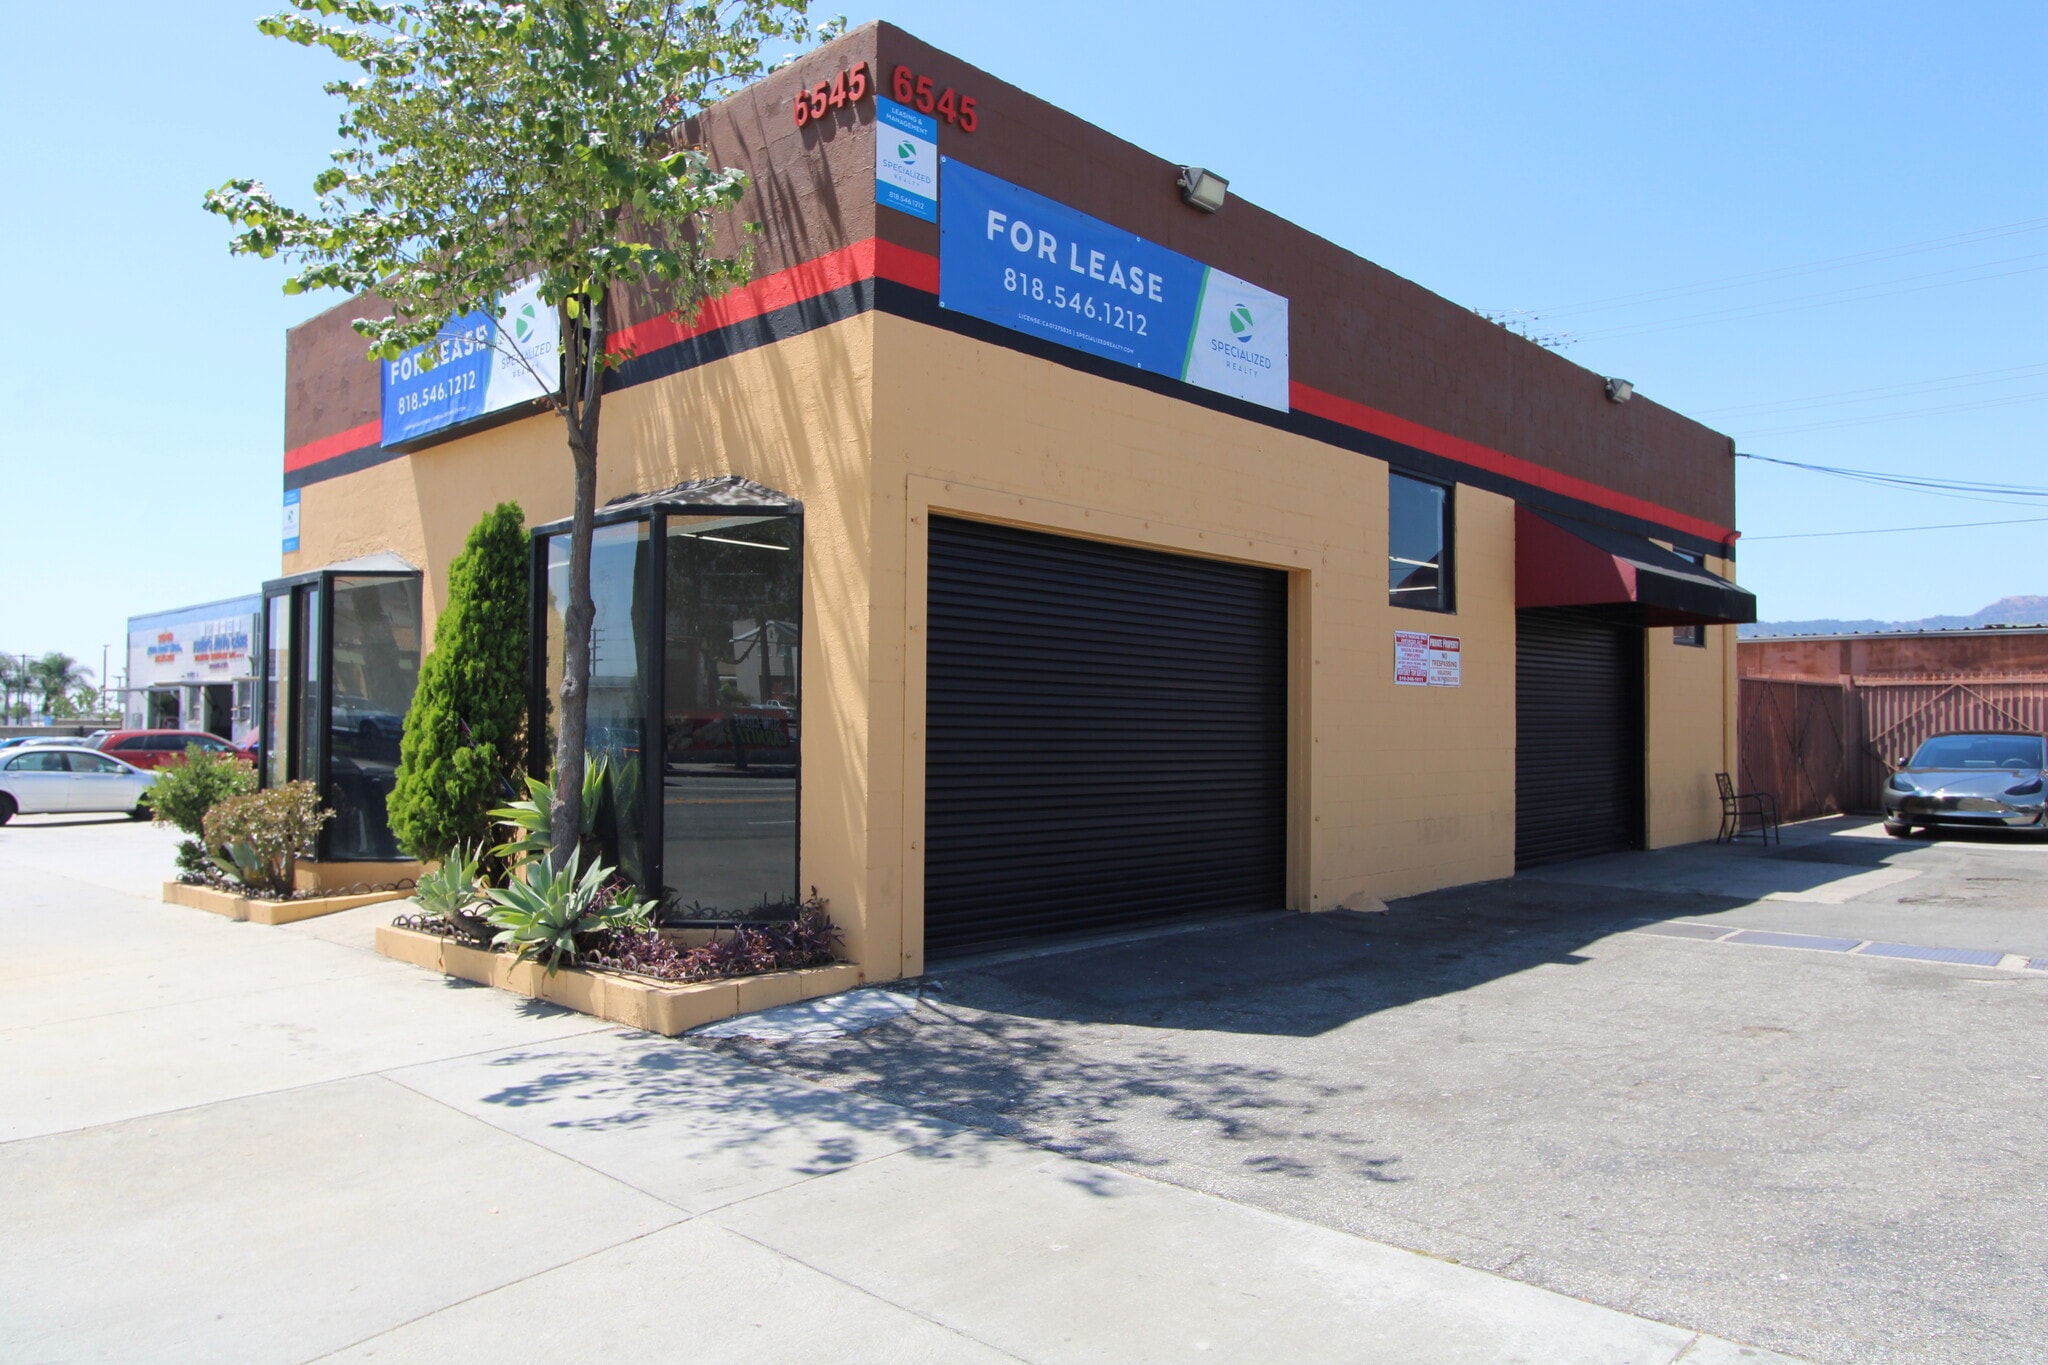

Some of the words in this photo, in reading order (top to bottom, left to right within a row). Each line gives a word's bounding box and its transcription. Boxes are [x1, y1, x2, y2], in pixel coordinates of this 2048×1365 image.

[793, 61, 867, 127] 6545
[893, 65, 979, 132] 6545
[886, 113, 928, 136] MANAGEMENT
[891, 107, 917, 123] LEASING
[882, 159, 932, 184] SPECIALIZED
[987, 209, 1057, 264] FOR
[1070, 242, 1163, 303] LEASE
[1003, 267, 1148, 337] 818.546.1212
[390, 352, 425, 386] FOR
[431, 325, 488, 370] EASE
[1211, 338, 1272, 370] SPECIALIZED
[1226, 360, 1259, 378] REALTY
[398, 370, 476, 415] 818.546.1212
[1432, 660, 1457, 668] TRESPASSING
